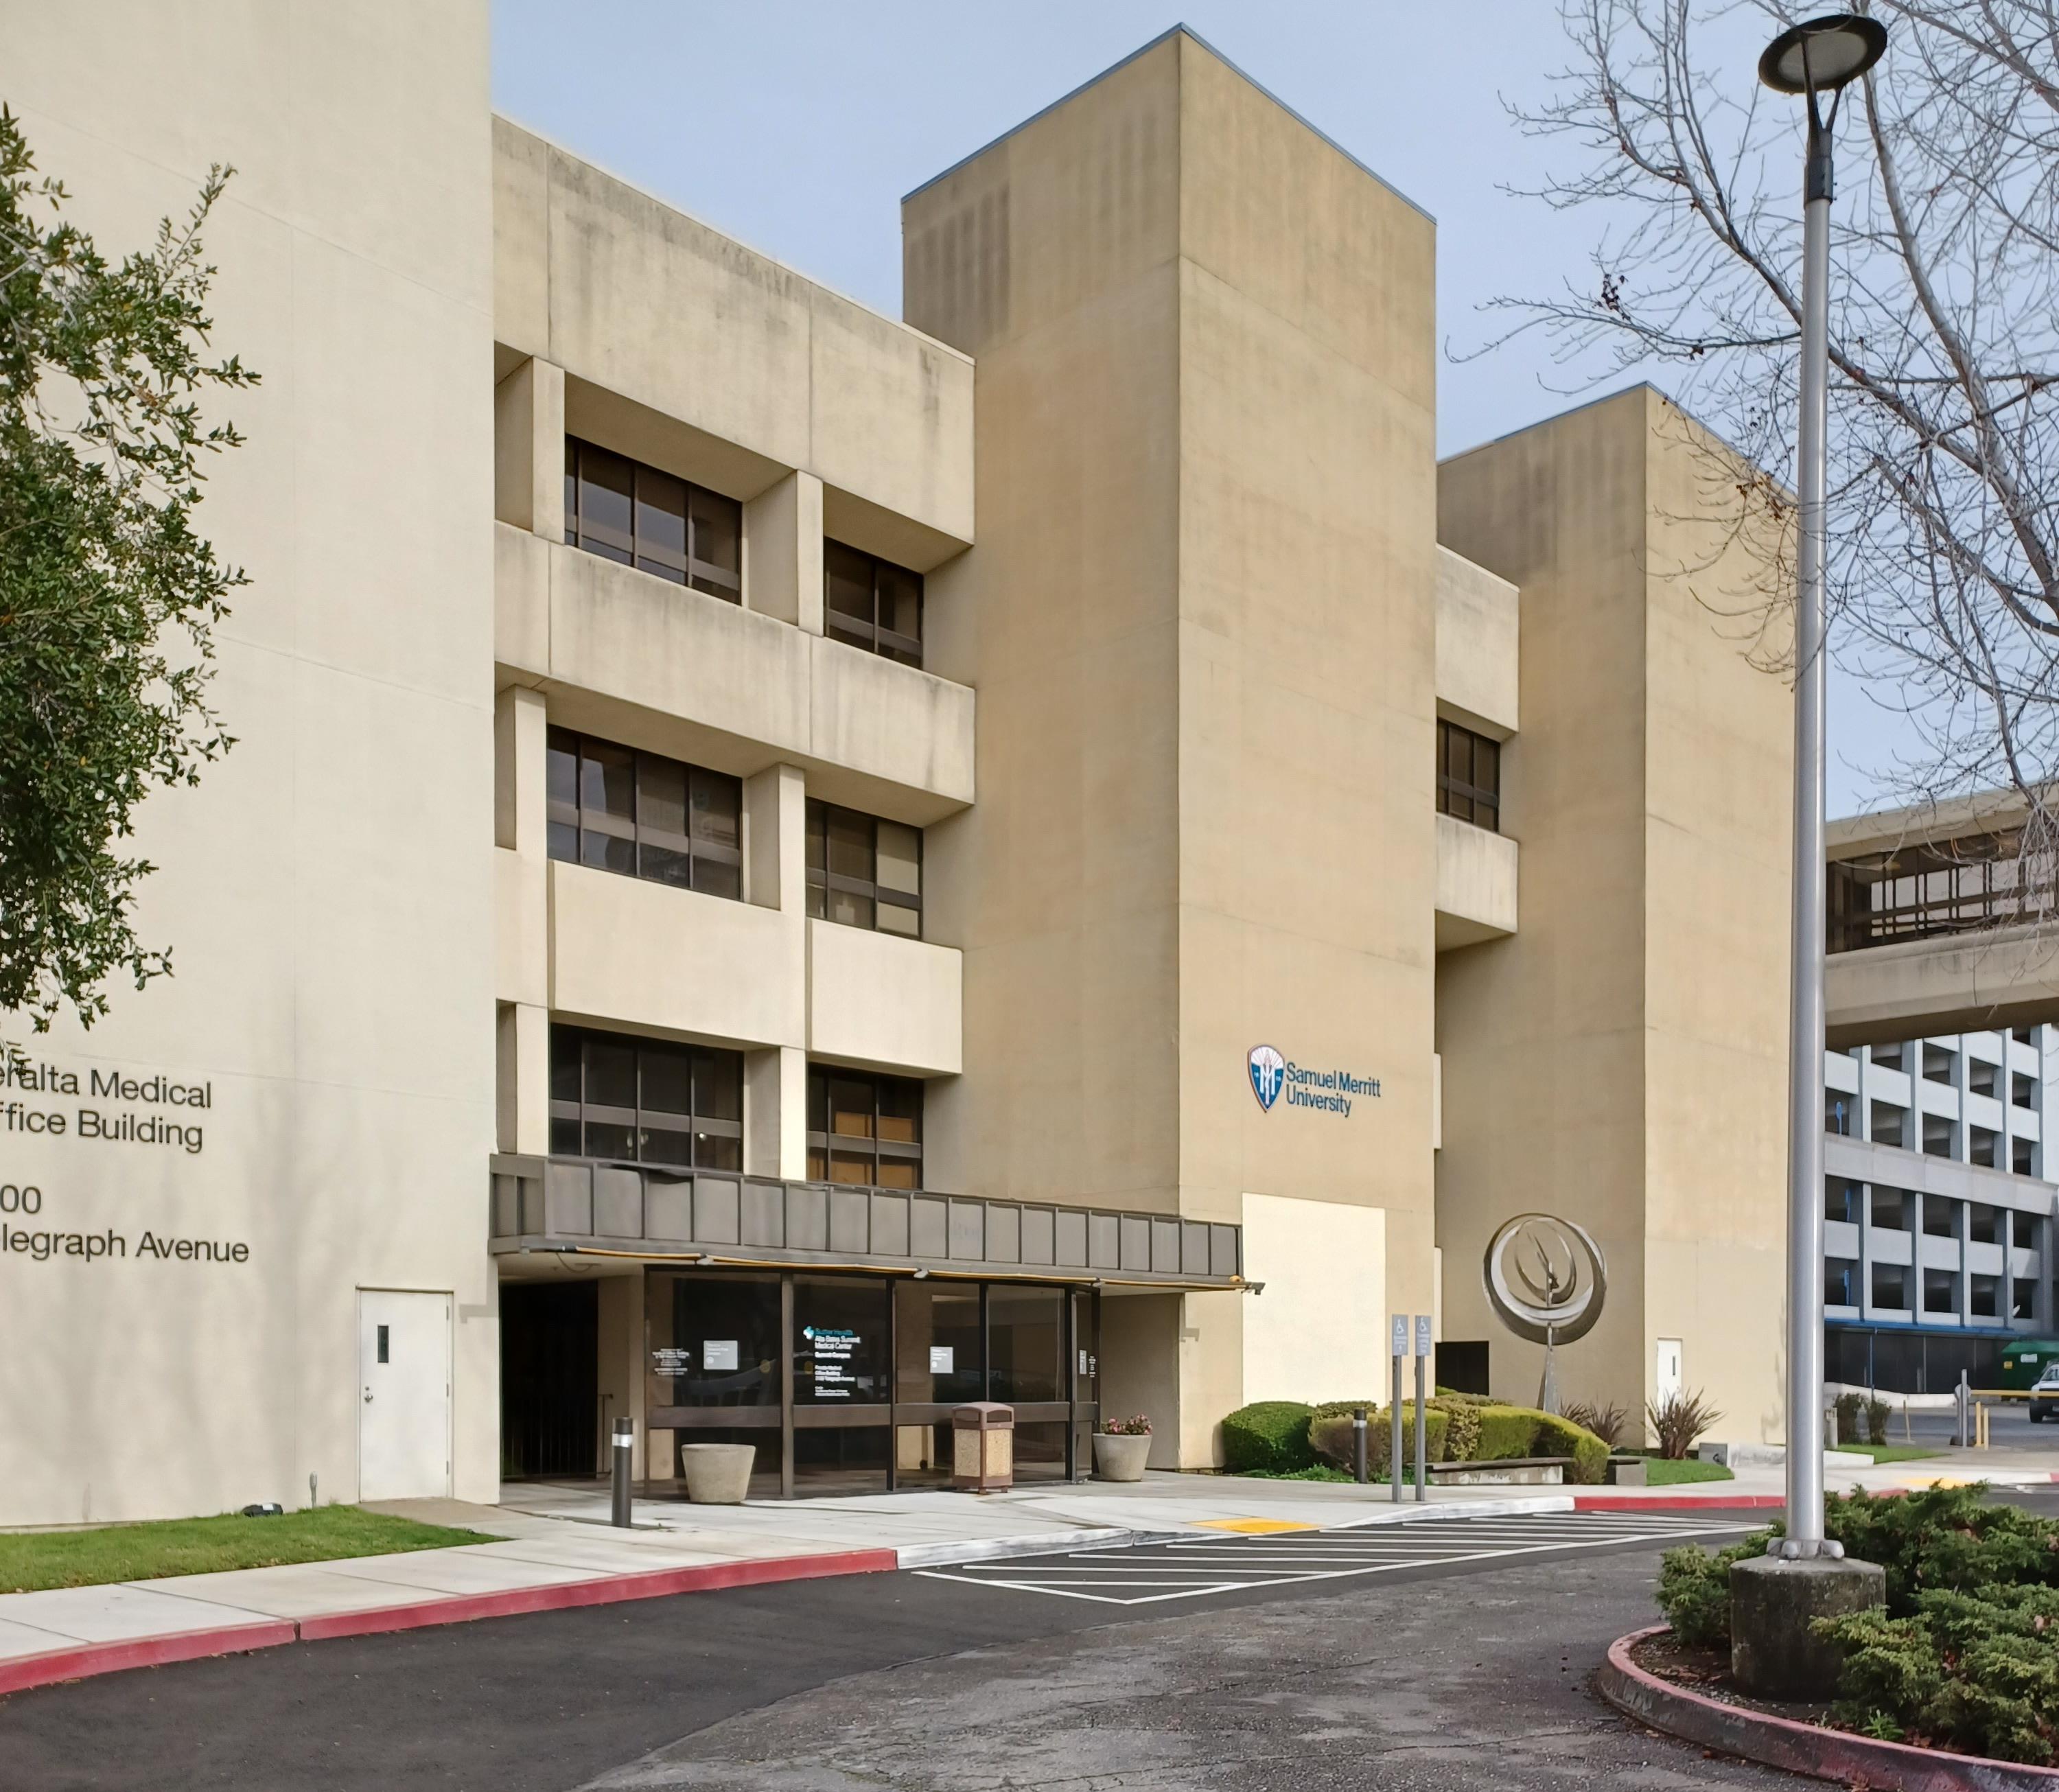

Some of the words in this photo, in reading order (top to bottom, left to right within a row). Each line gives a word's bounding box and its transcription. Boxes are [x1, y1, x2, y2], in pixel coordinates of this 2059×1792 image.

[0, 1062, 80, 1095] ralta
[91, 1069, 211, 1109] Medical
[1286, 1062, 1337, 1090] Samuel
[1338, 1071, 1381, 1097] Merritt
[1286, 1084, 1352, 1118] University
[78, 1109, 203, 1154] Building
[0, 1185, 41, 1214] 00
[2, 1222, 126, 1263] legraph
[135, 1231, 249, 1263] Avenue
